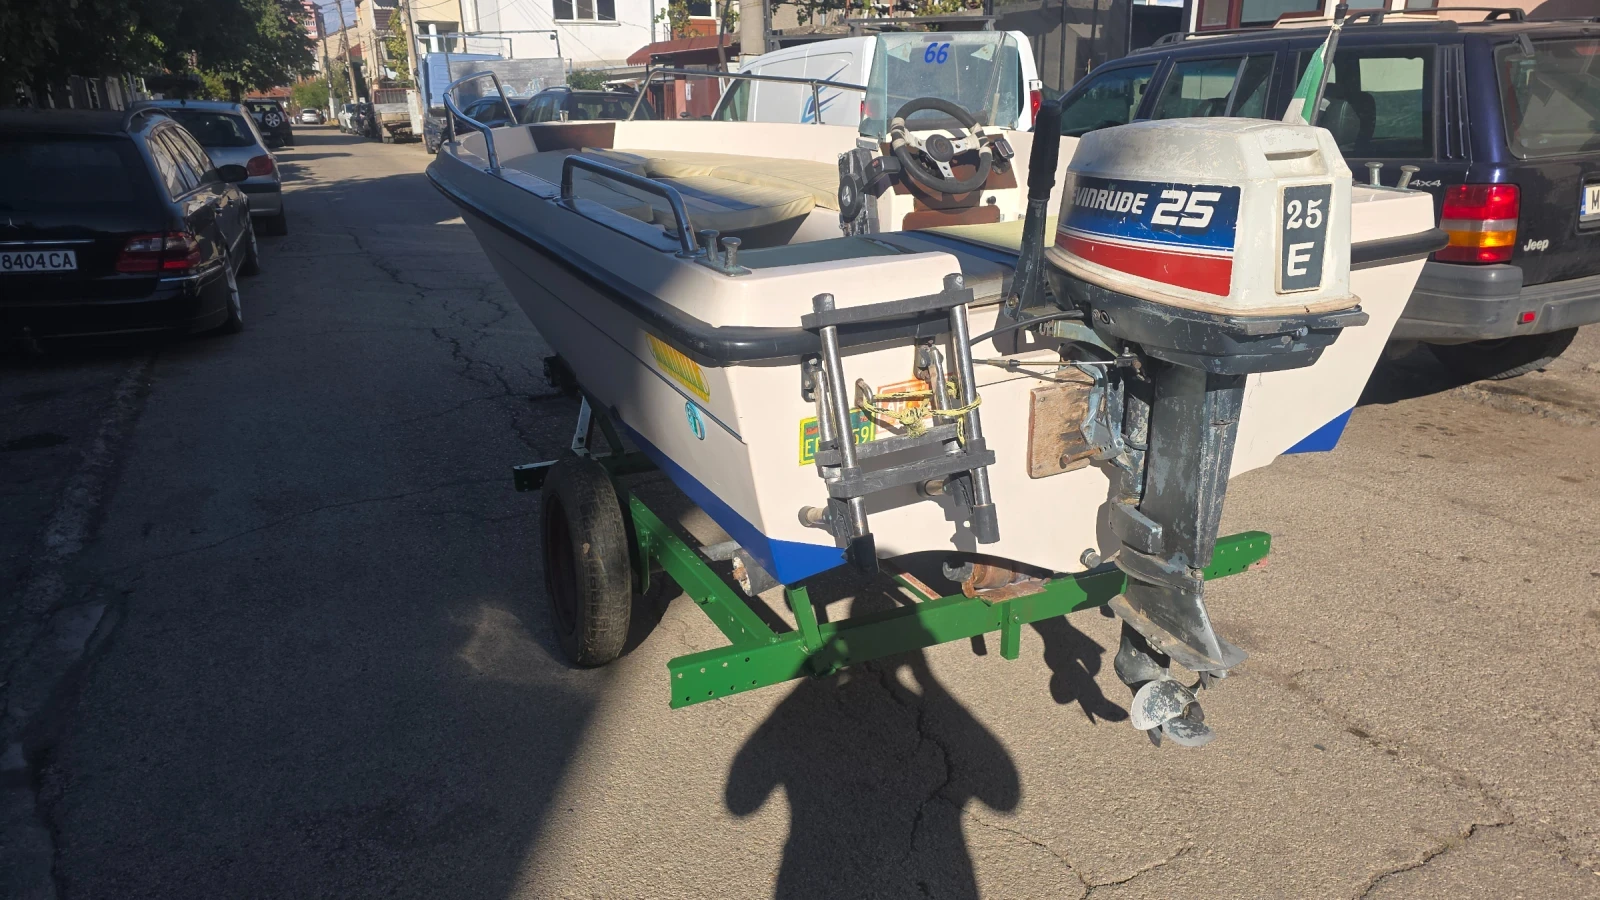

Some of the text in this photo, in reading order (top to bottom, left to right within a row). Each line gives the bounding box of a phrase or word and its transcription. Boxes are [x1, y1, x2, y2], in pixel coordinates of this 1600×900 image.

[924, 42, 950, 64] 66
[1151, 189, 1222, 228] 25
[1286, 199, 1323, 230] 25
[1524, 239, 1549, 251] Jeep
[2, 252, 74, 269] 8404 CA
[1287, 241, 1315, 277] E
